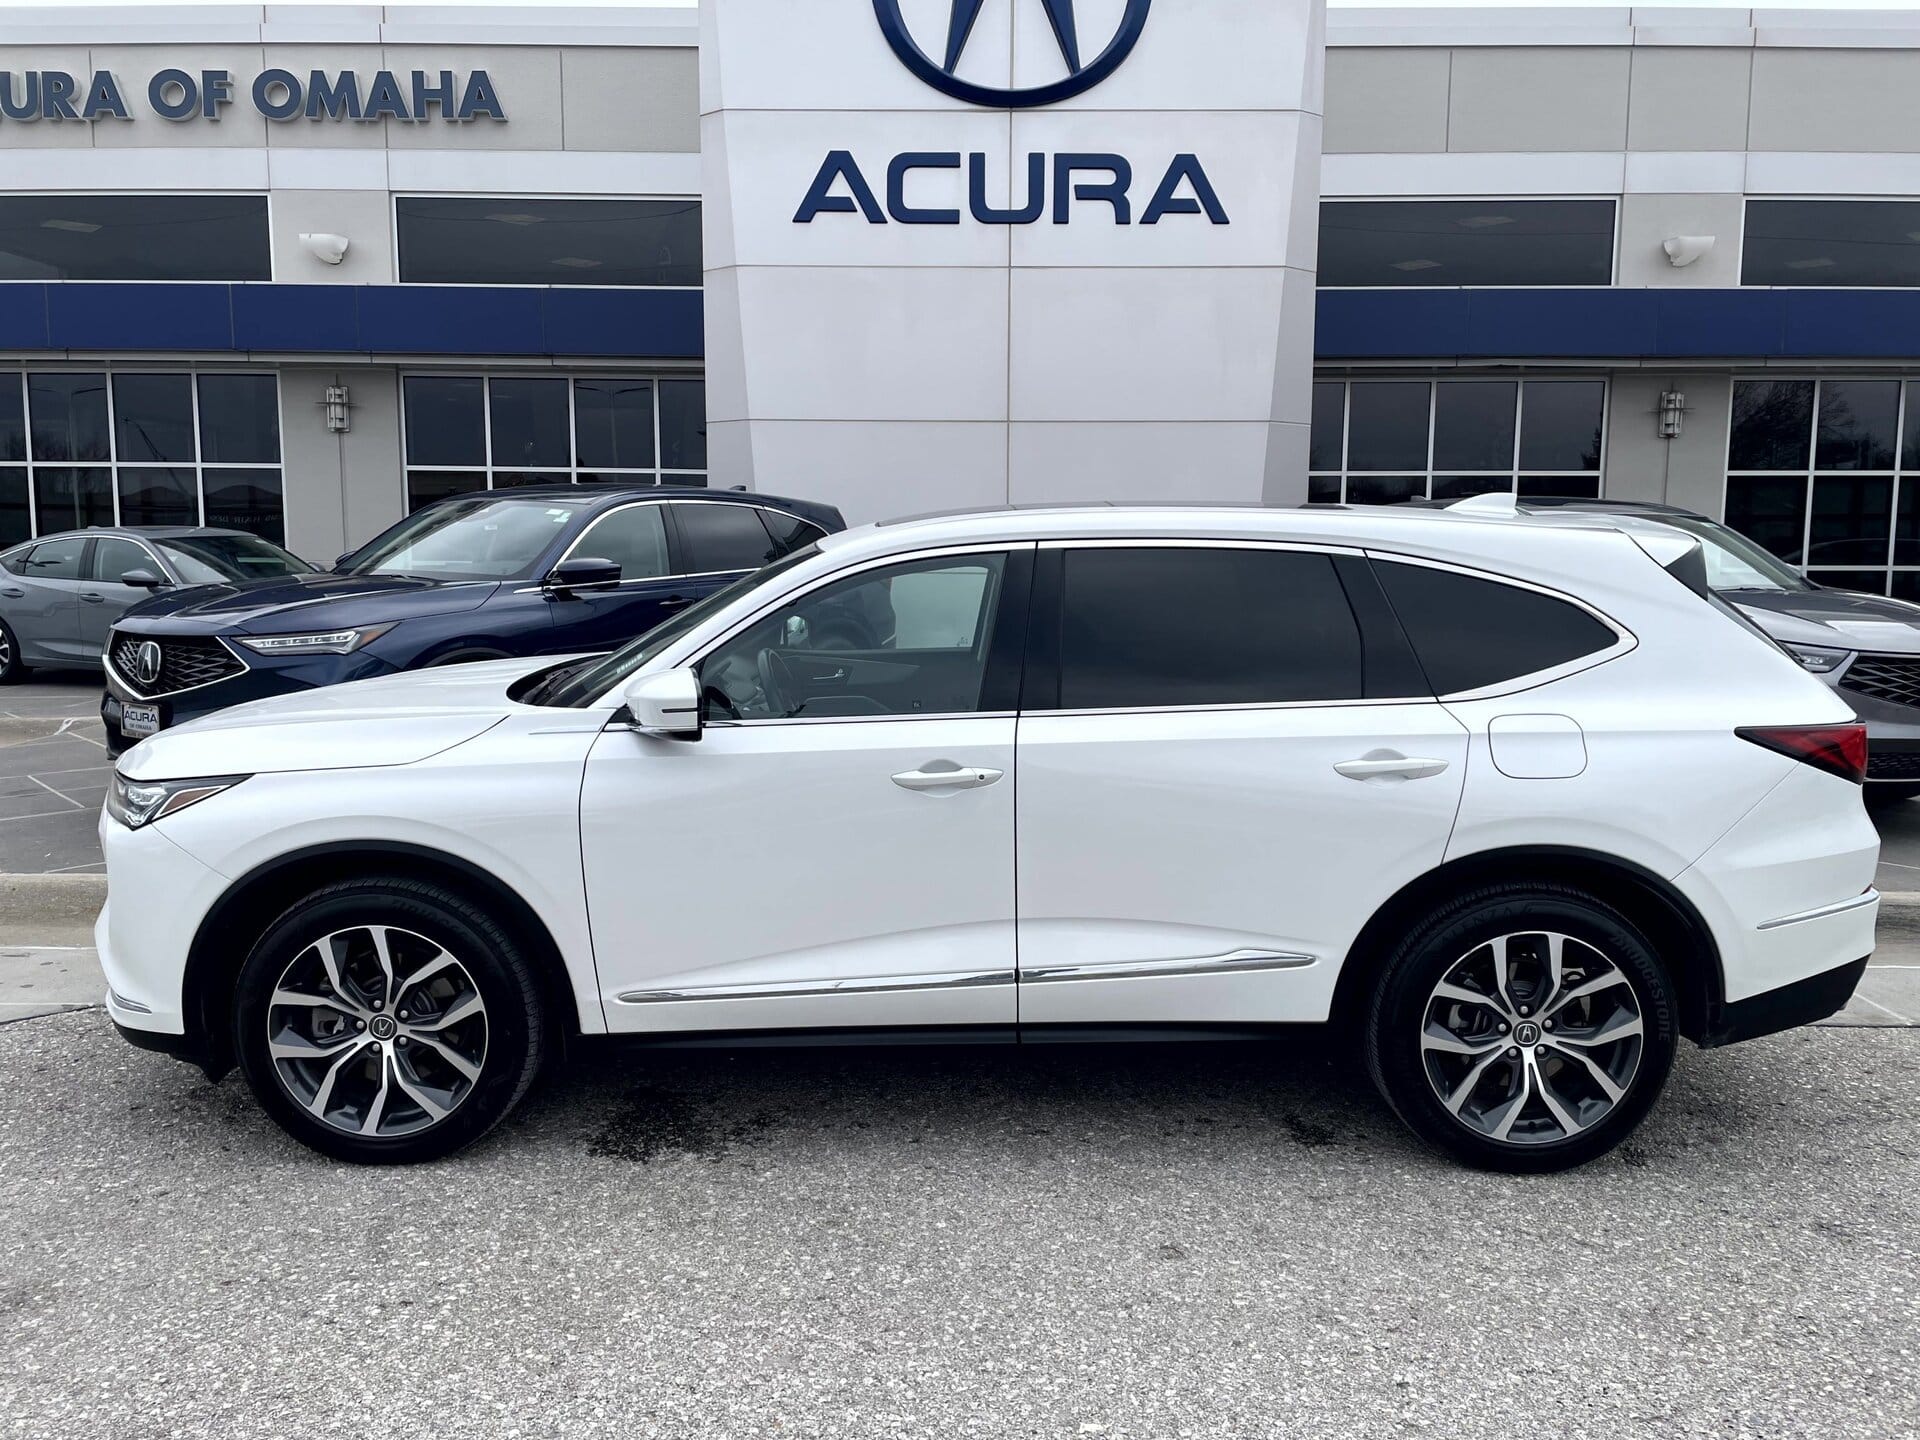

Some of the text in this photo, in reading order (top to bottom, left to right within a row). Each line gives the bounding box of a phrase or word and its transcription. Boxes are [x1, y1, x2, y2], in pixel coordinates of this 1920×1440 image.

[148, 68, 232, 121] OF
[252, 69, 507, 122] OMAHA
[792, 150, 1230, 225] ACURA
[124, 710, 158, 724] ACURA
